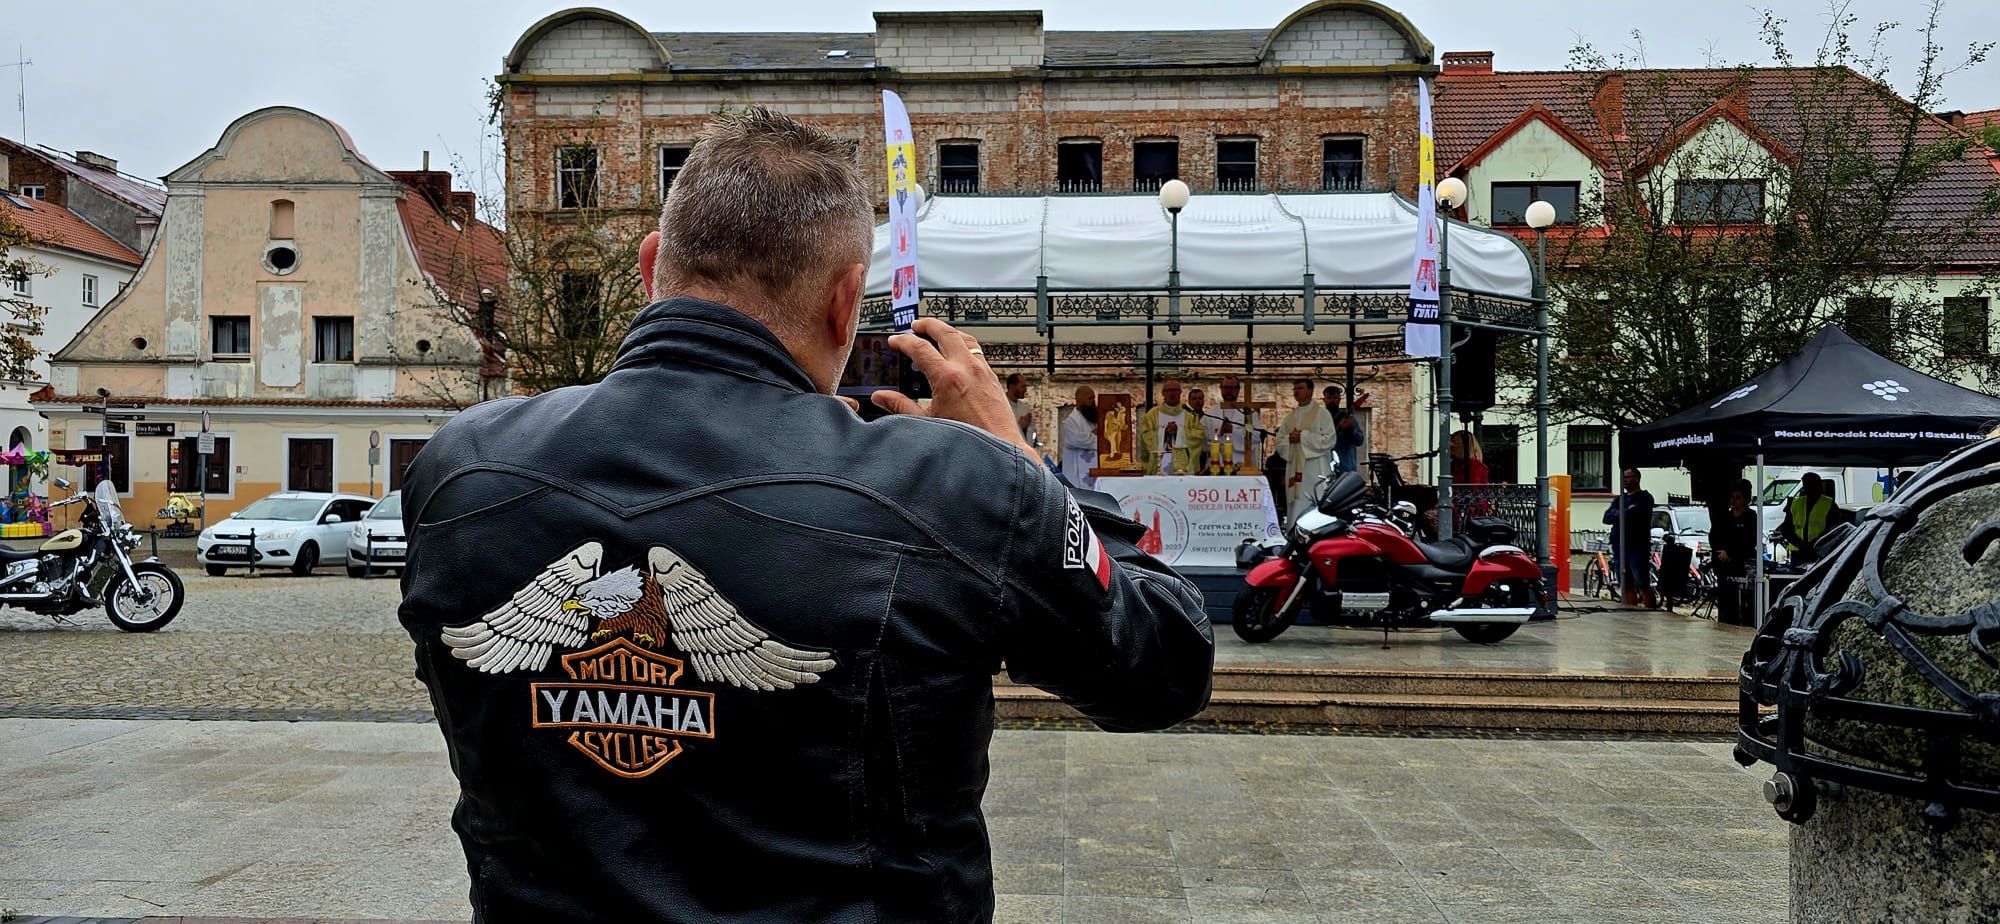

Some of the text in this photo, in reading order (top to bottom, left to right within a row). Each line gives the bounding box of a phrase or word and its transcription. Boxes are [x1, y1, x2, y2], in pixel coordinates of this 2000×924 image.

[1652, 432, 1714, 449] www.pokis.pl
[1814, 430, 1867, 438] Ośrodek
[1869, 430, 1917, 440] Kultury
[1925, 431, 1964, 439] Sztuki
[1188, 488, 1220, 503] 950
[1225, 488, 1261, 503] LAT
[1188, 503, 1262, 511] DIECEZJI PŁOCKIEJ
[1191, 522, 1197, 530] 7
[1233, 522, 1253, 530] 2025
[580, 648, 668, 685] MOTOR
[541, 690, 708, 735] YAMAHA
[584, 731, 668, 768] CYCLES
